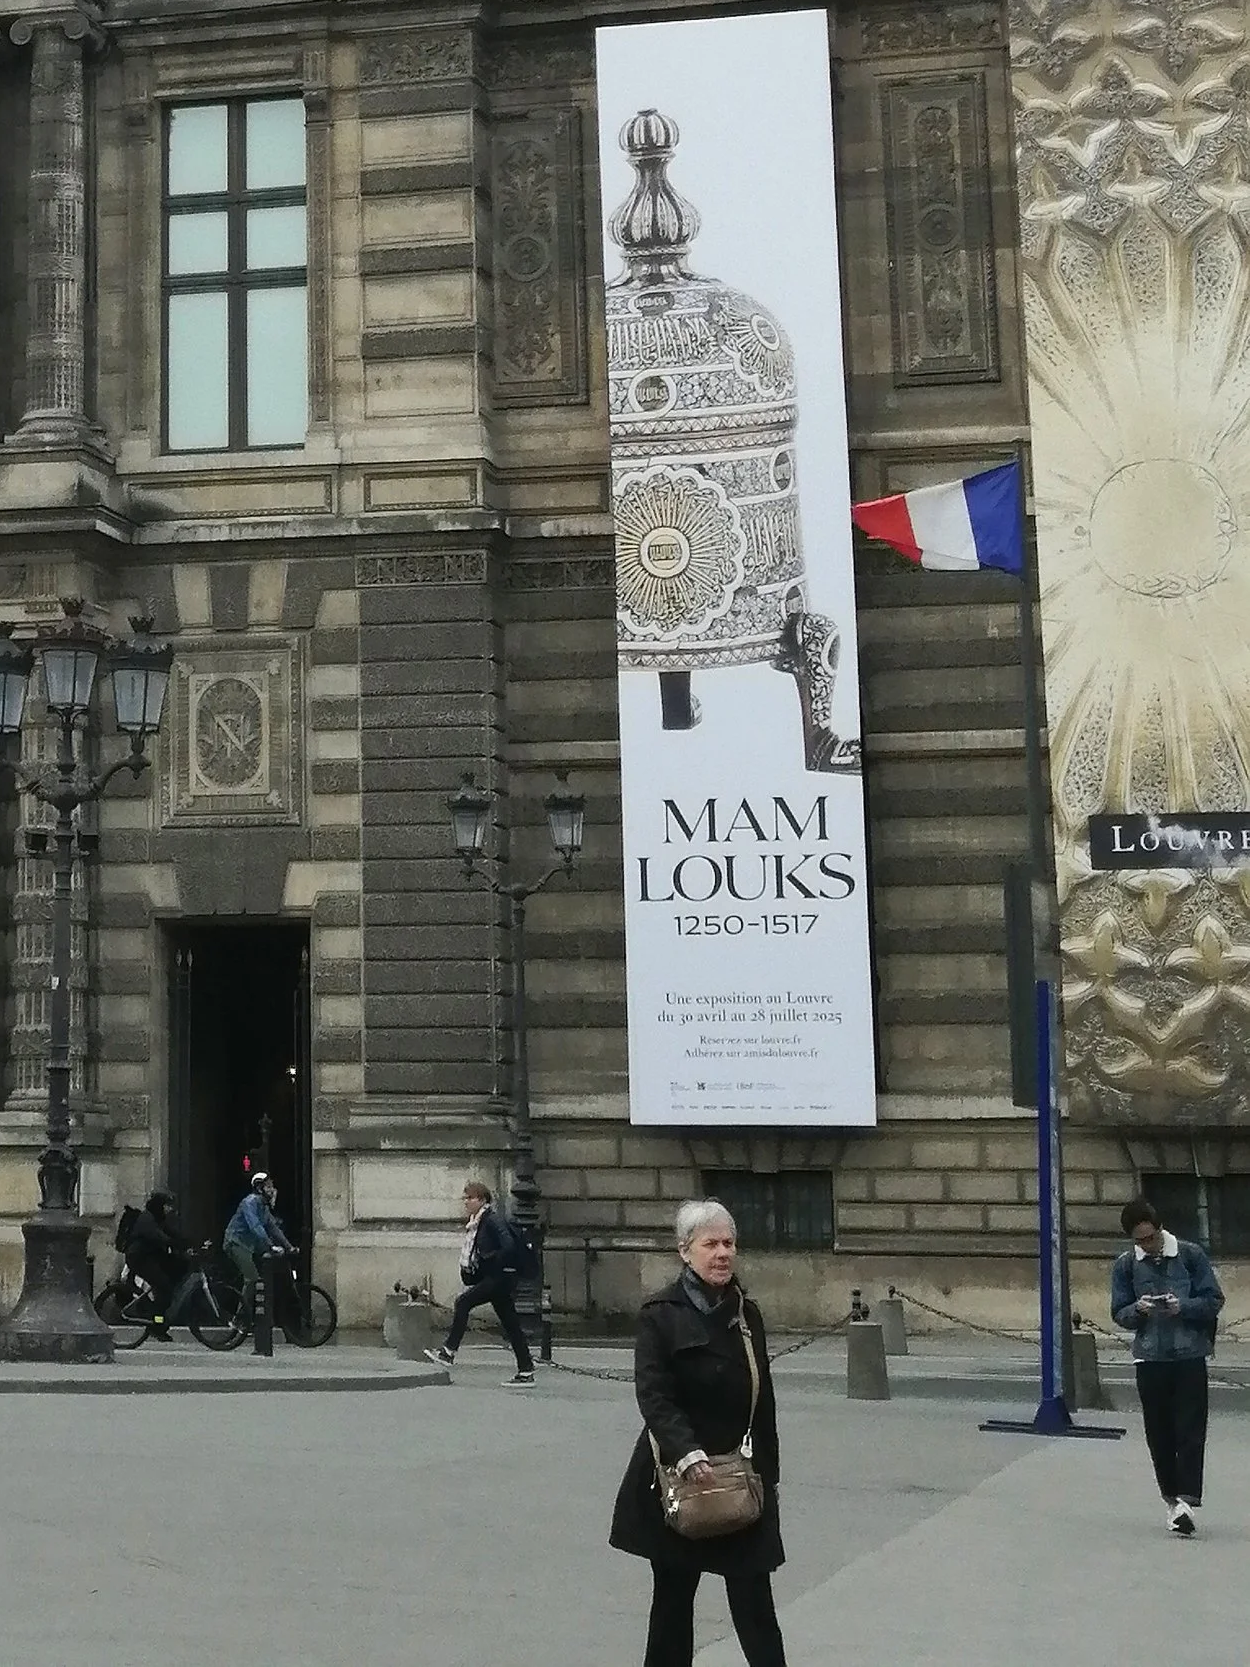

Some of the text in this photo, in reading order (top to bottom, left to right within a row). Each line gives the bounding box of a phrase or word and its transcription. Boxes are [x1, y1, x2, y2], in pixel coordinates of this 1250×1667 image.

[661, 795, 830, 843] MAM
[636, 852, 856, 902] LOUKS
[674, 914, 819, 936] 1250-1517
[665, 991, 834, 1009] Une exposition au Louvre
[657, 1008, 842, 1026] du 30 avril au 28 juillet 2025
